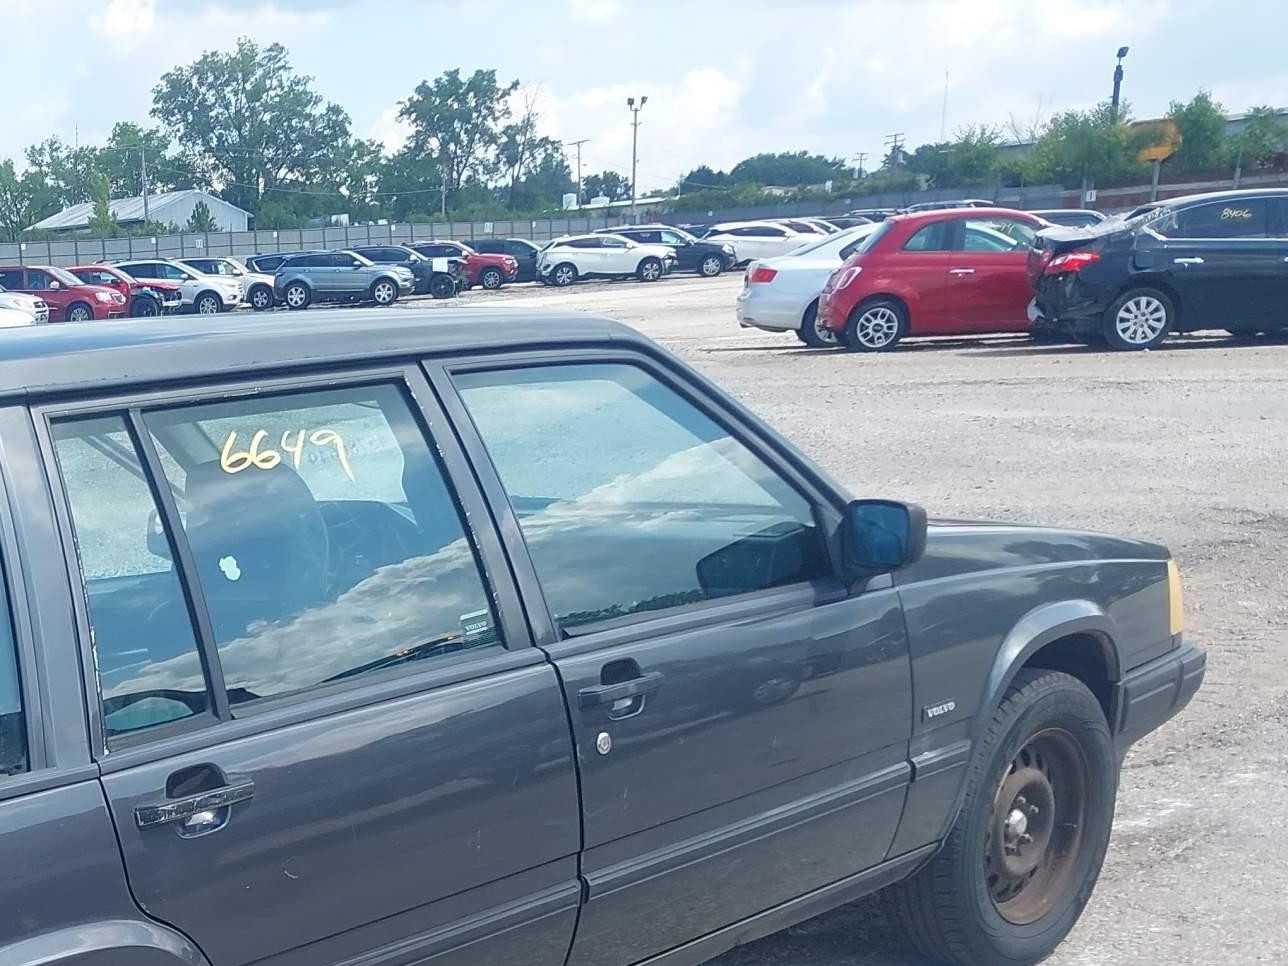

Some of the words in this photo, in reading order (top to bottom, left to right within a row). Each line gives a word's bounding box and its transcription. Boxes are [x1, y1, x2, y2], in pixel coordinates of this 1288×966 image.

[1221, 207, 1252, 220] 8406
[220, 429, 355, 481] 6649
[464, 620, 488, 631] VOLVO
[927, 701, 956, 718] VOLVO
